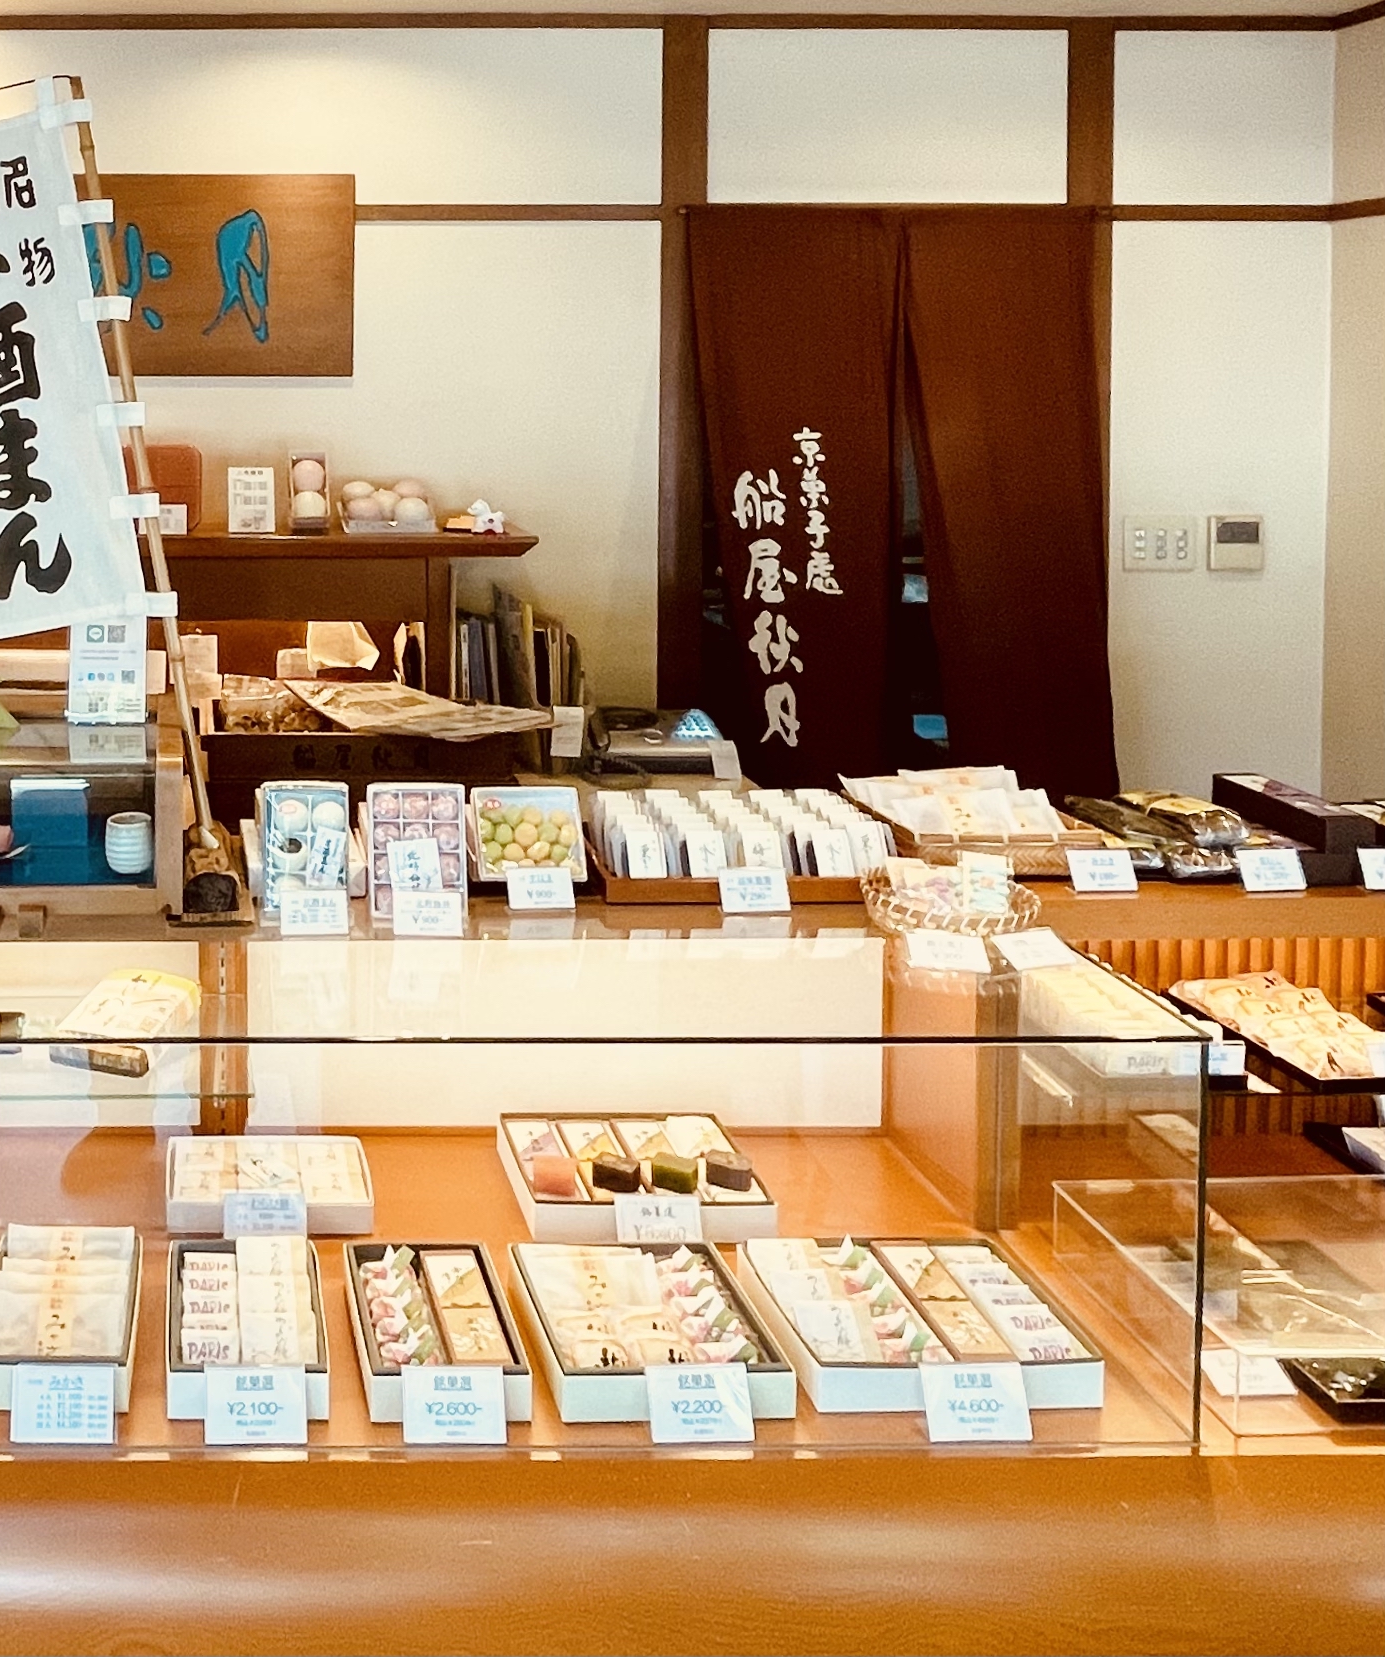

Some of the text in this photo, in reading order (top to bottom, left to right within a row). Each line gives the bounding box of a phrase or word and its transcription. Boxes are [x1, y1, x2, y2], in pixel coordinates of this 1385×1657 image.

[0, 155, 55, 287] 名物
[731, 468, 804, 747] 船屋秋月
